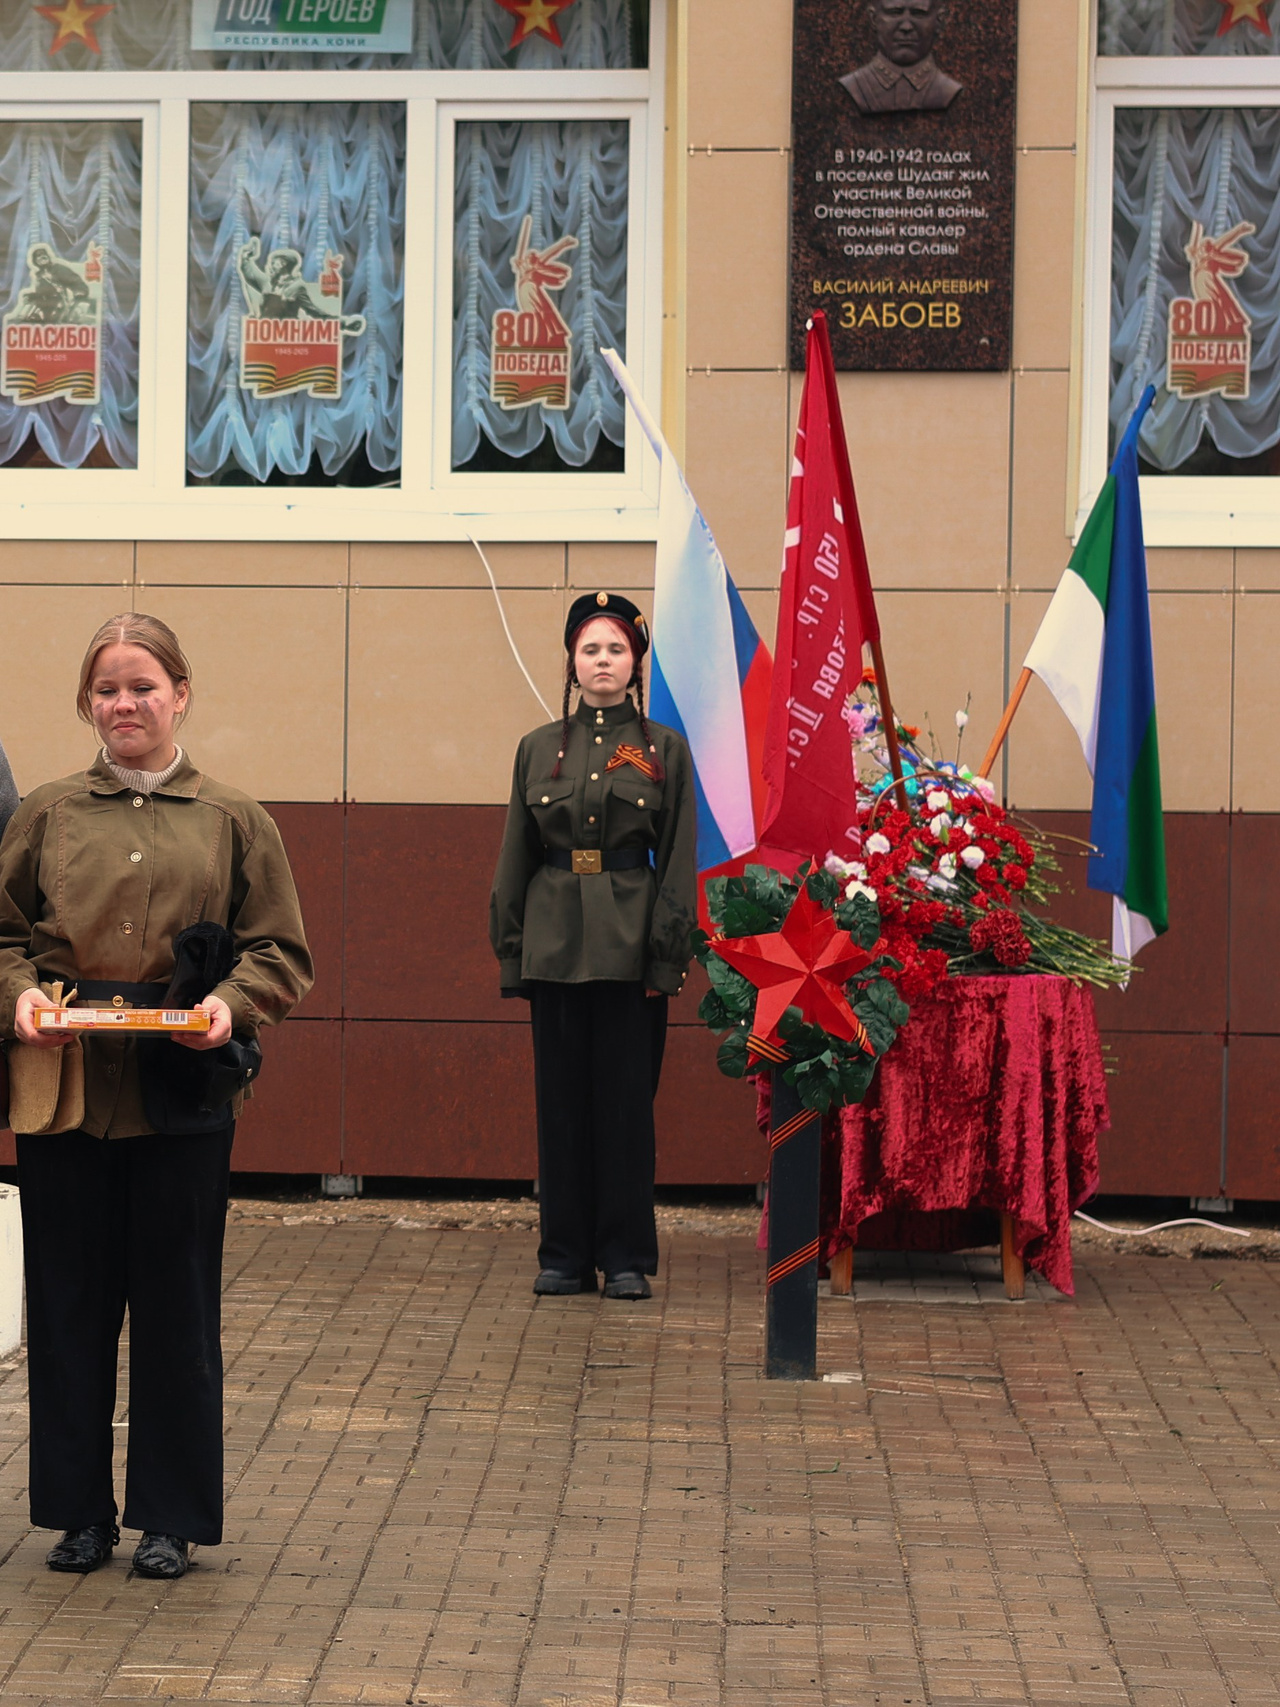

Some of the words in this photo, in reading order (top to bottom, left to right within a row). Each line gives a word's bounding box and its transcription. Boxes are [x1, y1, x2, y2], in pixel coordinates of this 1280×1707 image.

[225, 0, 271, 25] ГОД
[285, 0, 375, 22] ГЕРОЕВ
[224, 36, 320, 47] РЕСПУБЛИКА
[326, 37, 367, 47] КОМИ
[835, 150, 843, 163] В
[850, 149, 923, 163] 1940-1942
[927, 151, 971, 164] годах
[816, 171, 824, 182] в
[827, 171, 894, 182] поселке
[898, 168, 954, 184] Шудаяг
[959, 171, 989, 181] жил
[833, 189, 902, 203] участник
[907, 187, 971, 199] Великой
[814, 203, 934, 219] Отечественной
[838, 223, 895, 237] полный
[900, 225, 966, 238] кавалер
[844, 243, 905, 257] ордена
[909, 241, 959, 256] Славы
[813, 278, 893, 294] ВАСИЛИЙ
[898, 279, 989, 295] АНДРЕЕВИЧ
[839, 302, 962, 328] ЗАБОЕВ
[1173, 300, 1216, 336] 80
[6, 327, 96, 348] СПАСИБО!
[245, 320, 339, 342] ПОМНИМ!
[496, 312, 536, 347] 80
[1172, 343, 1247, 364] ПОБЕДА!
[495, 354, 568, 375] ПОБЕДА!
